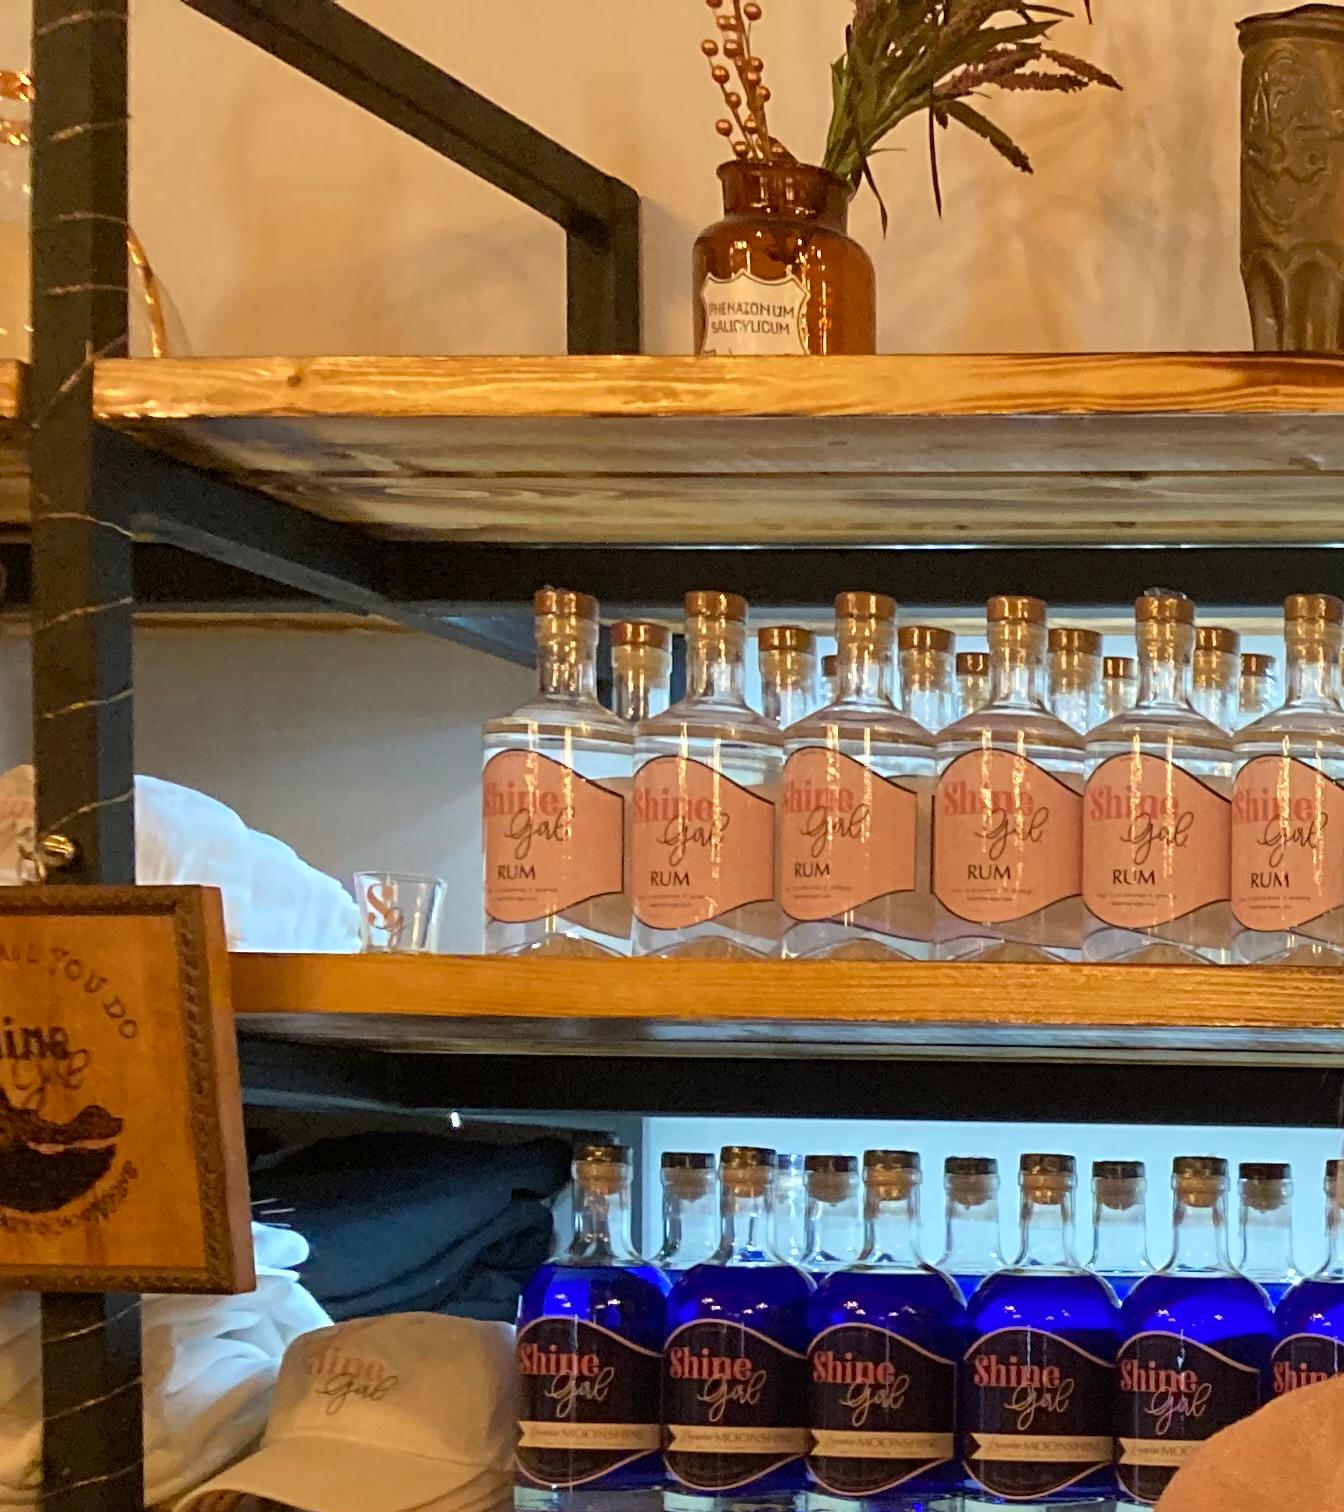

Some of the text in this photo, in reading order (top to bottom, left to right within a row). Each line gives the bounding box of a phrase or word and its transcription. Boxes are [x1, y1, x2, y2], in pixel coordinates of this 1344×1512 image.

[709, 302, 794, 318] PHENAZONUM
[711, 320, 790, 335] SALICYLICUM
[943, 778, 1035, 817] Shne
[1234, 788, 1313, 824] Shie
[497, 865, 536, 880] RUM
[651, 870, 690, 887] RUM
[794, 862, 830, 878] RUM
[967, 864, 1011, 881] RUM
[1112, 869, 1155, 885] RUM
[1250, 872, 1290, 888] RUM
[0, 942, 37, 964] LL
[0, 1017, 69, 1060] ine
[518, 1343, 600, 1377] Shine
[669, 1346, 752, 1381] Shine
[812, 1351, 897, 1385] Shine
[974, 1355, 1060, 1389] Shine
[1120, 1359, 1198, 1393] Shine
[1272, 1360, 1342, 1393] Shin
